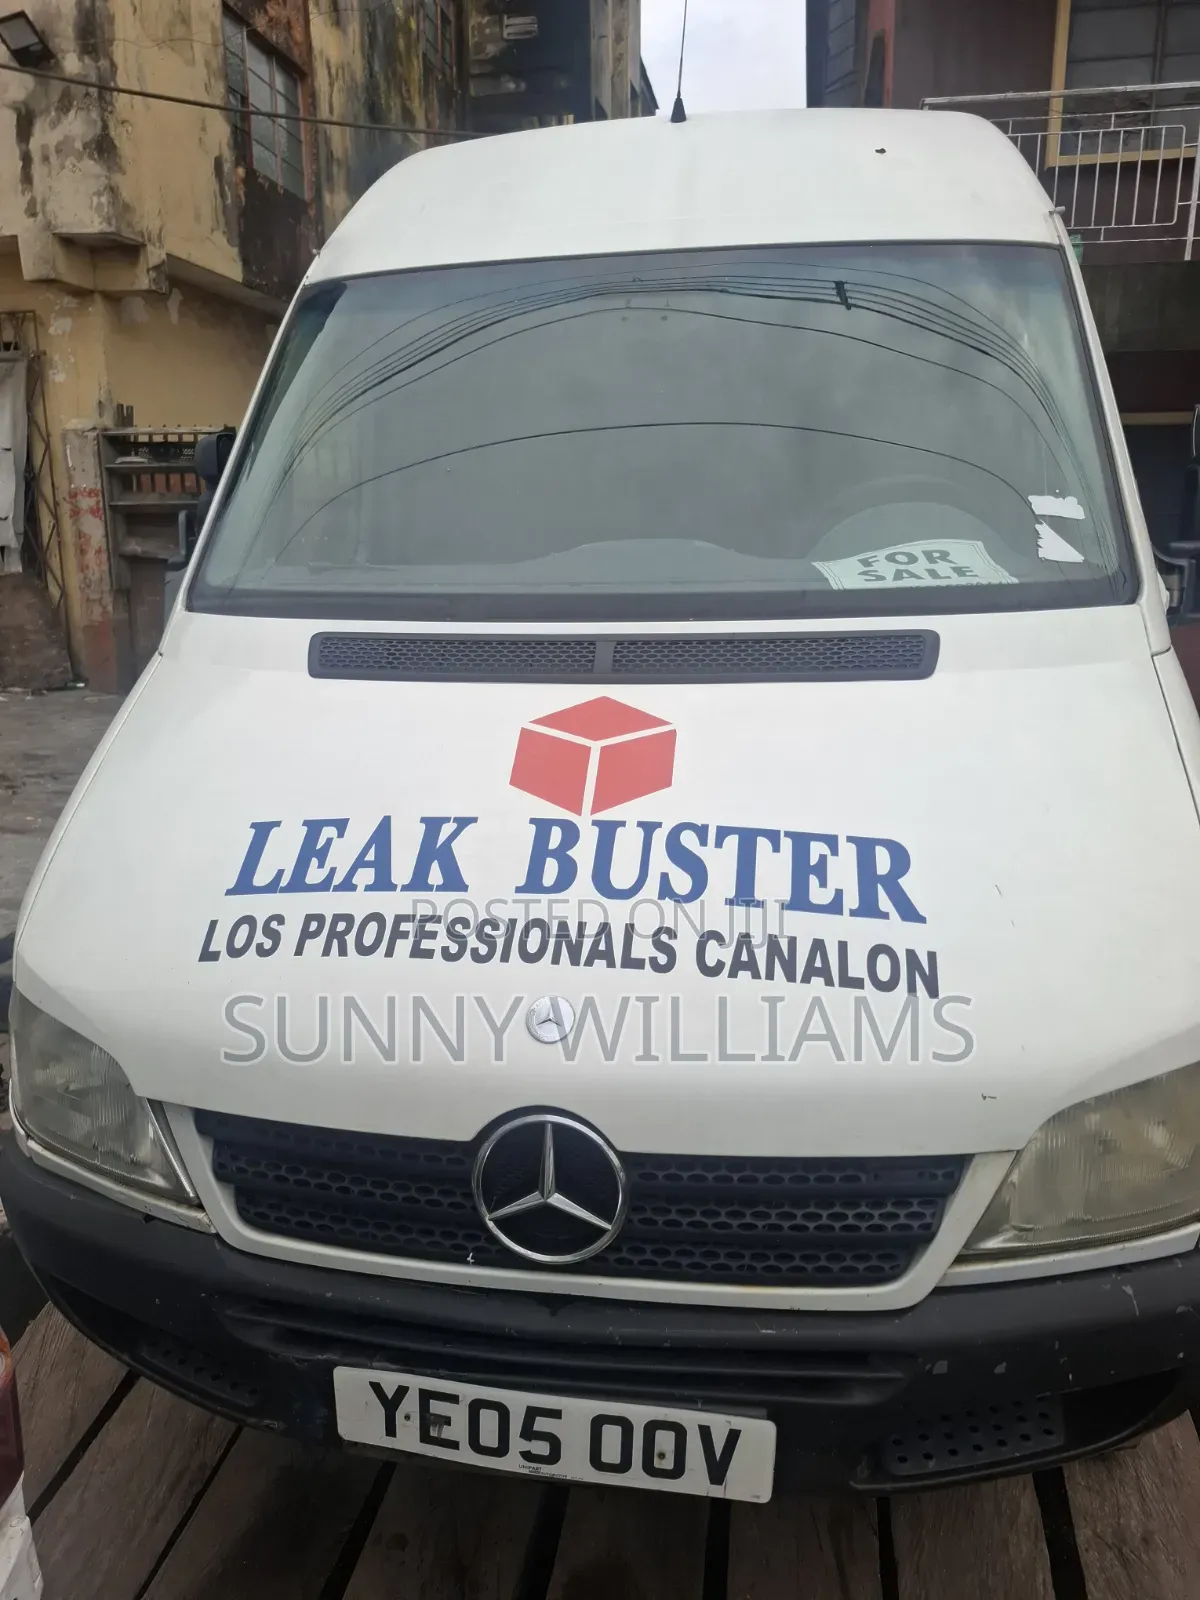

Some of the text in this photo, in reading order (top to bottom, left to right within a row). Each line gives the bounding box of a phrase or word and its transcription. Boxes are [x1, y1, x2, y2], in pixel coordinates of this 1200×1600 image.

[857, 566, 979, 582] SALE
[858, 549, 957, 568] FOR
[225, 816, 927, 925] LEAK BUSTER
[198, 911, 941, 999] LOS PROFESSIONALS CANALON
[368, 1381, 742, 1486] YE05 OOV
